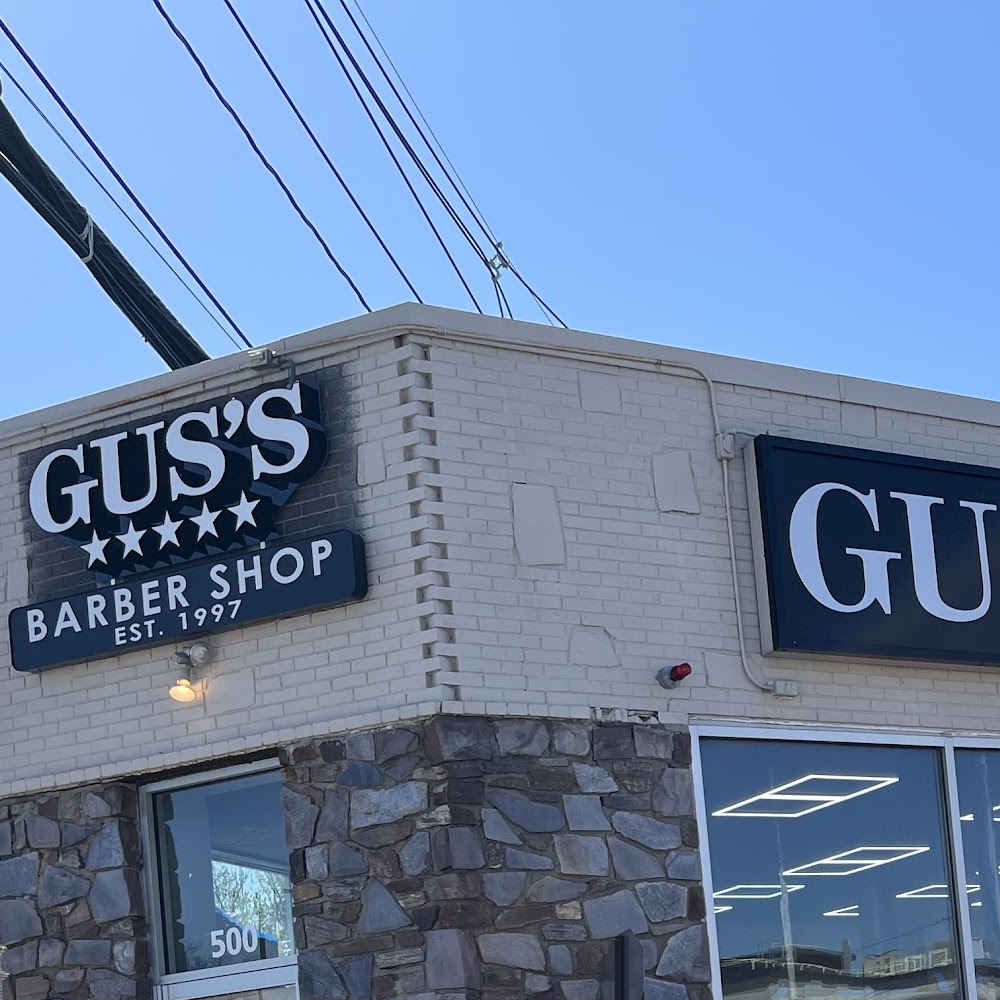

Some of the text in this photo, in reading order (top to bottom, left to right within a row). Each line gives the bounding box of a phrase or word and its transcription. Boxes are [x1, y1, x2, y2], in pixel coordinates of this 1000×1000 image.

[29, 383, 310, 533] GUS'S
[27, 539, 333, 643] BARBER SHOP
[114, 600, 242, 646] EST. 1997
[210, 926, 258, 958] 500
